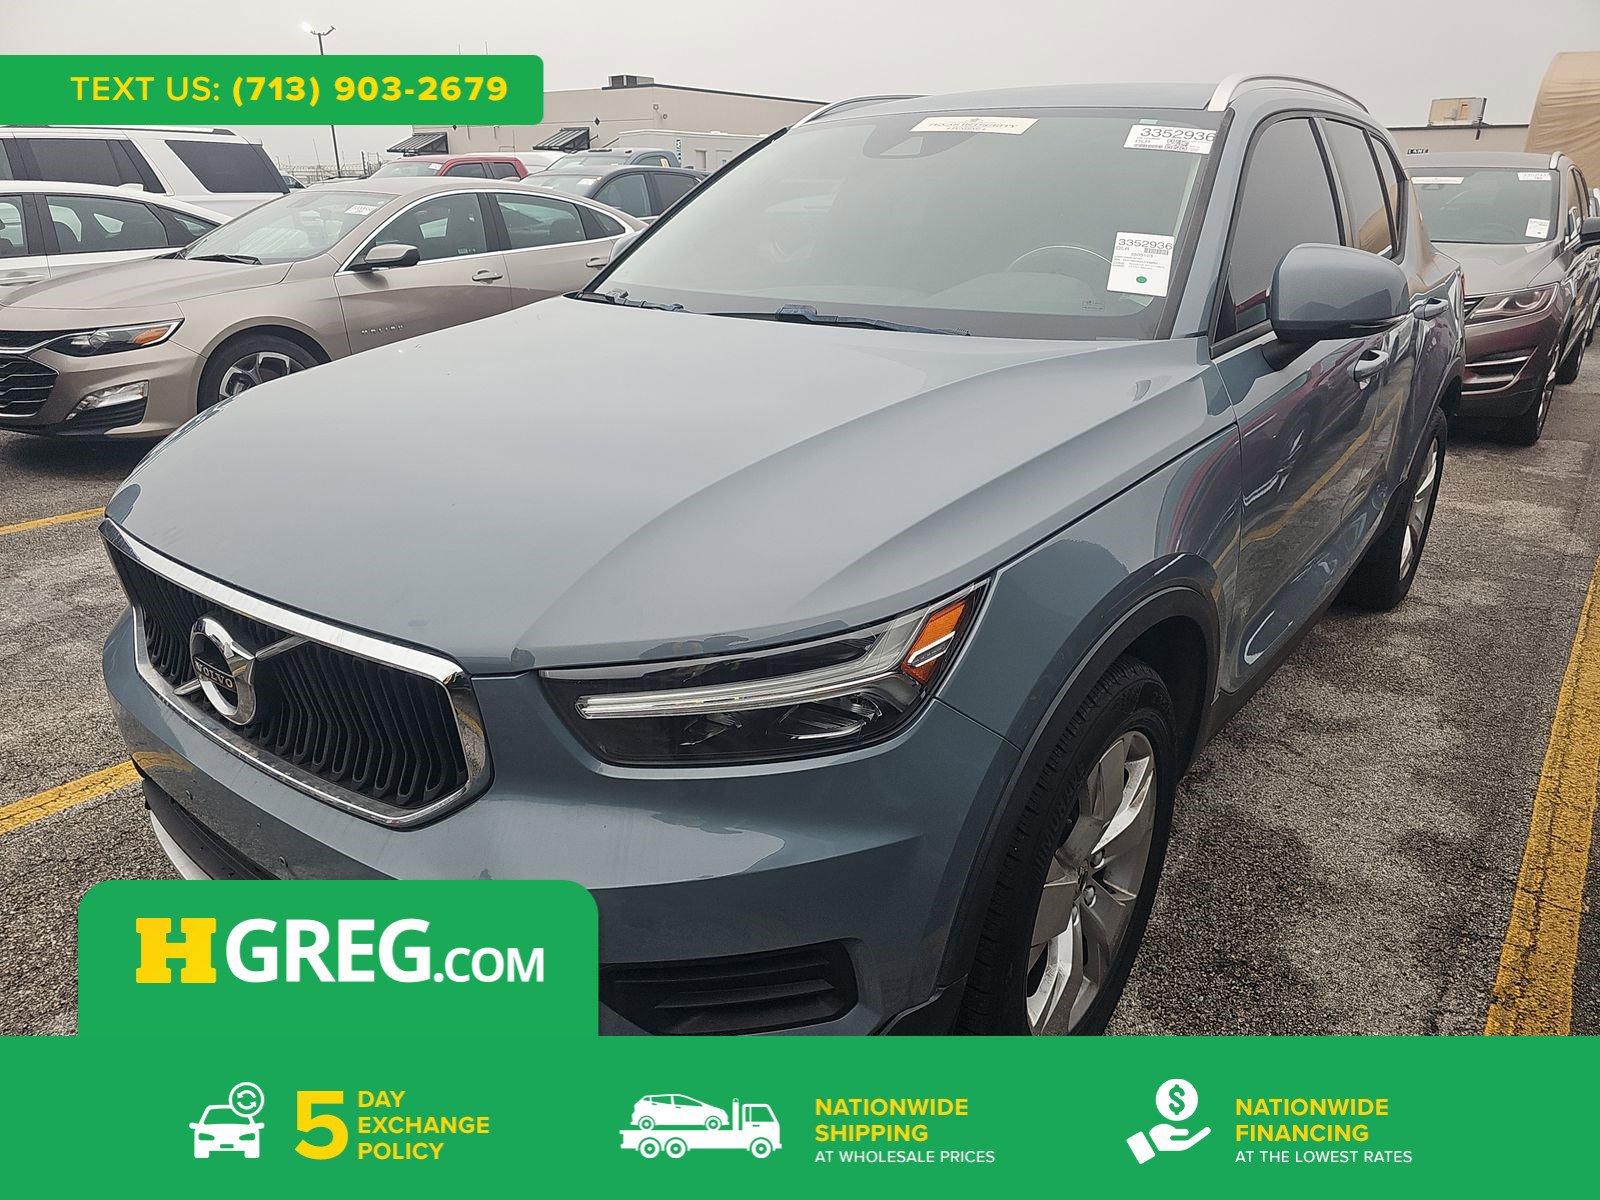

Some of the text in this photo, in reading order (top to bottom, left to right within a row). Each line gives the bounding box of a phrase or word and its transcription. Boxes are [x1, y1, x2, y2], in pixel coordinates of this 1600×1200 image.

[1140, 127, 1216, 142] 3352936
[1118, 238, 1173, 250] 3352936
[194, 661, 232, 688] VOLVO
